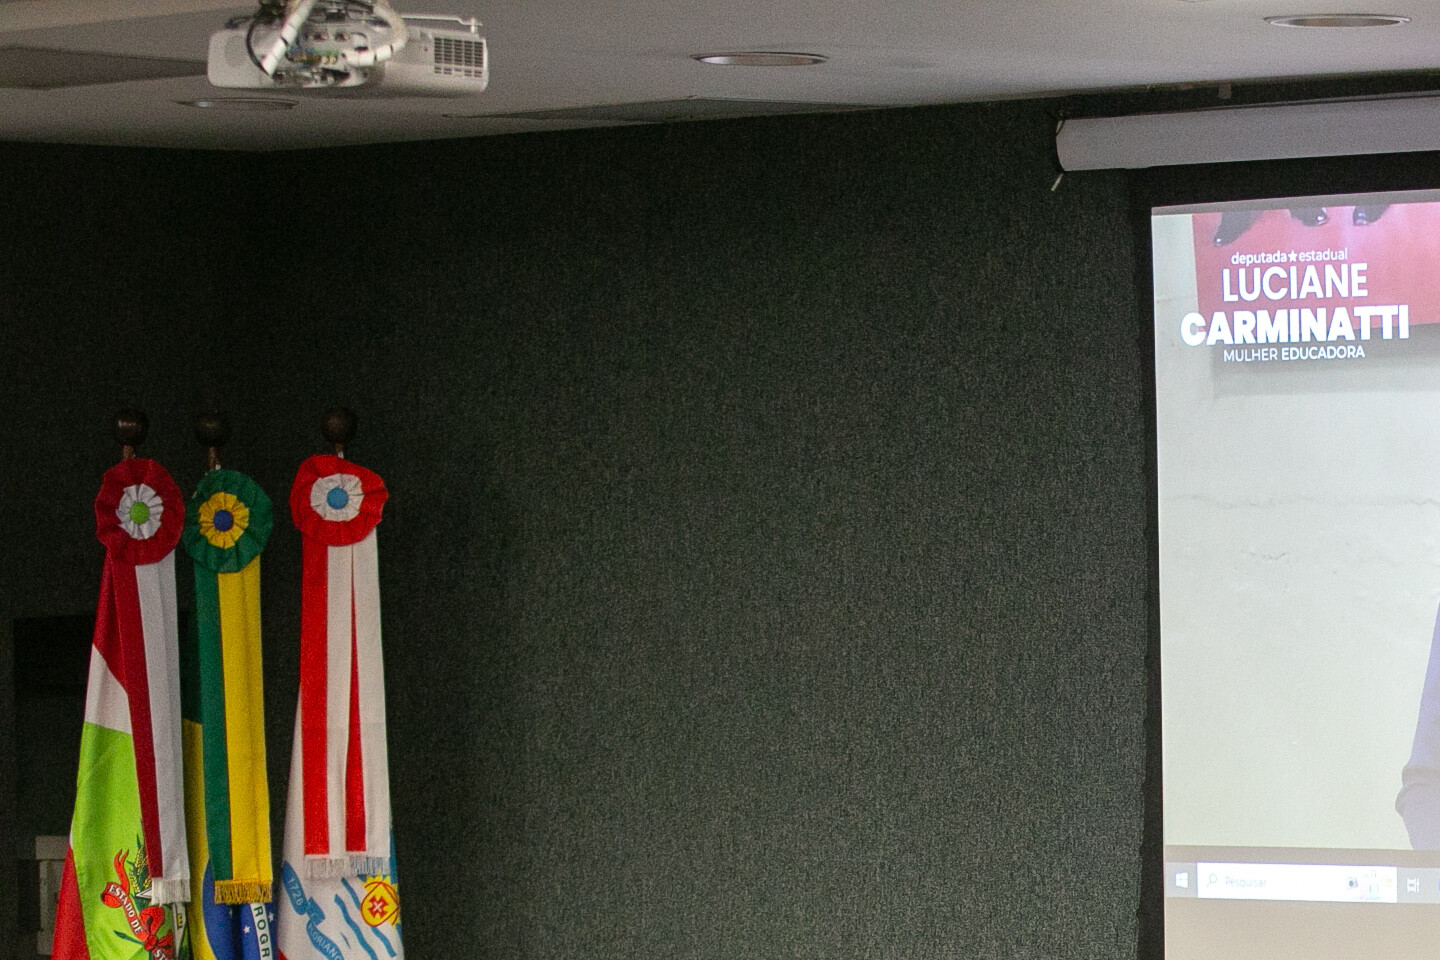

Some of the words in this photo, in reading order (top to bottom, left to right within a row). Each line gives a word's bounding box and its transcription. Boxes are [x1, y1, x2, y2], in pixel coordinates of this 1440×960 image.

[1231, 250, 1287, 266] deputada
[1299, 248, 1348, 262] estadual
[1222, 263, 1368, 302] LUCIANE
[1180, 305, 1409, 346] CARMINATTI
[1224, 348, 1278, 362] MULHER
[1281, 345, 1366, 361] EDUCADORA
[1225, 876, 1267, 889] Pesquisar
[108, 884, 136, 918] ESTADO
[130, 920, 142, 935] DE
